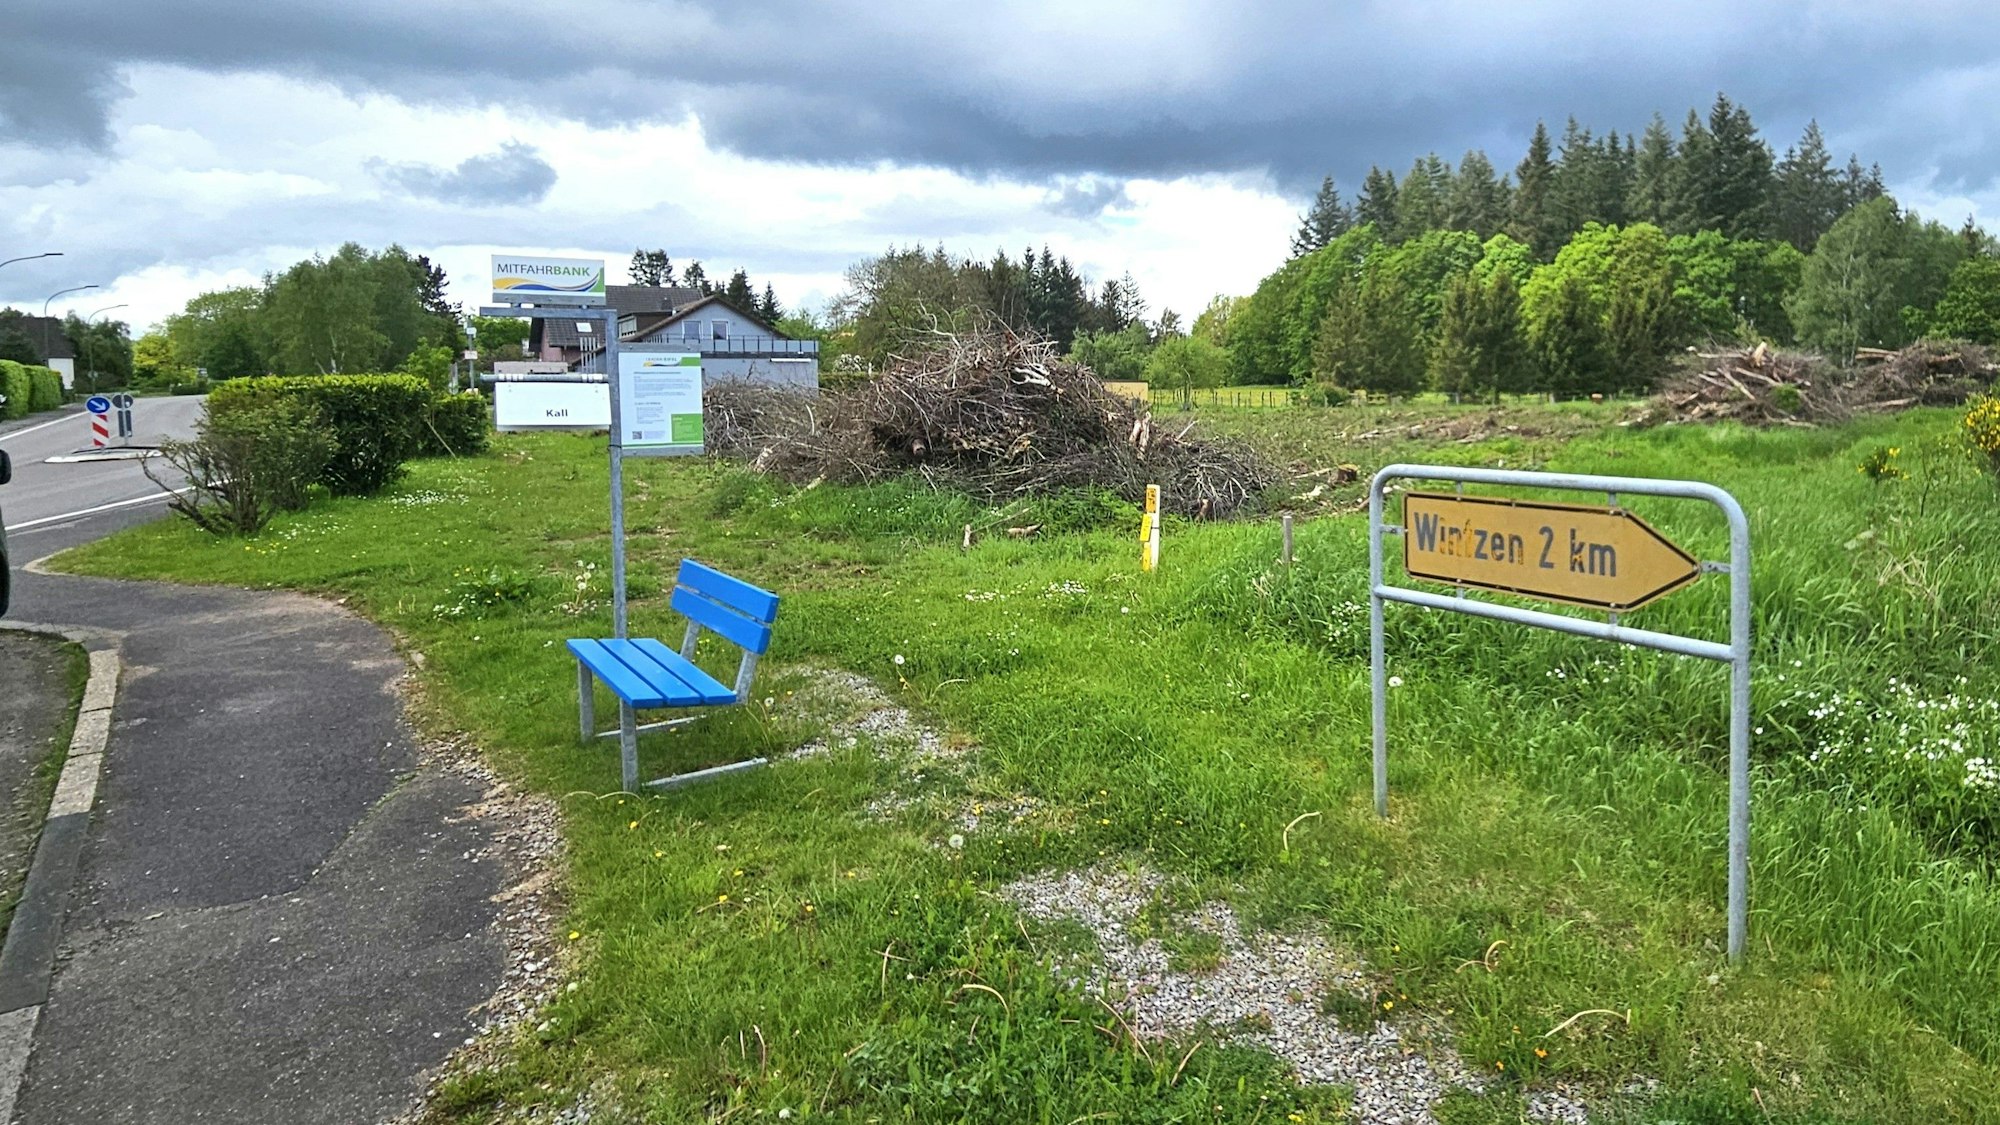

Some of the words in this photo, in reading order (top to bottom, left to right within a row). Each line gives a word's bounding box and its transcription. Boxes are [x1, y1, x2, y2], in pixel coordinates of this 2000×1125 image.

[497, 263, 590, 277] MITFAHRBANK
[546, 409, 568, 417] Kall
[1413, 511, 1524, 566] Wintzen
[1539, 526, 1554, 569] 2
[1570, 528, 1617, 577] km
